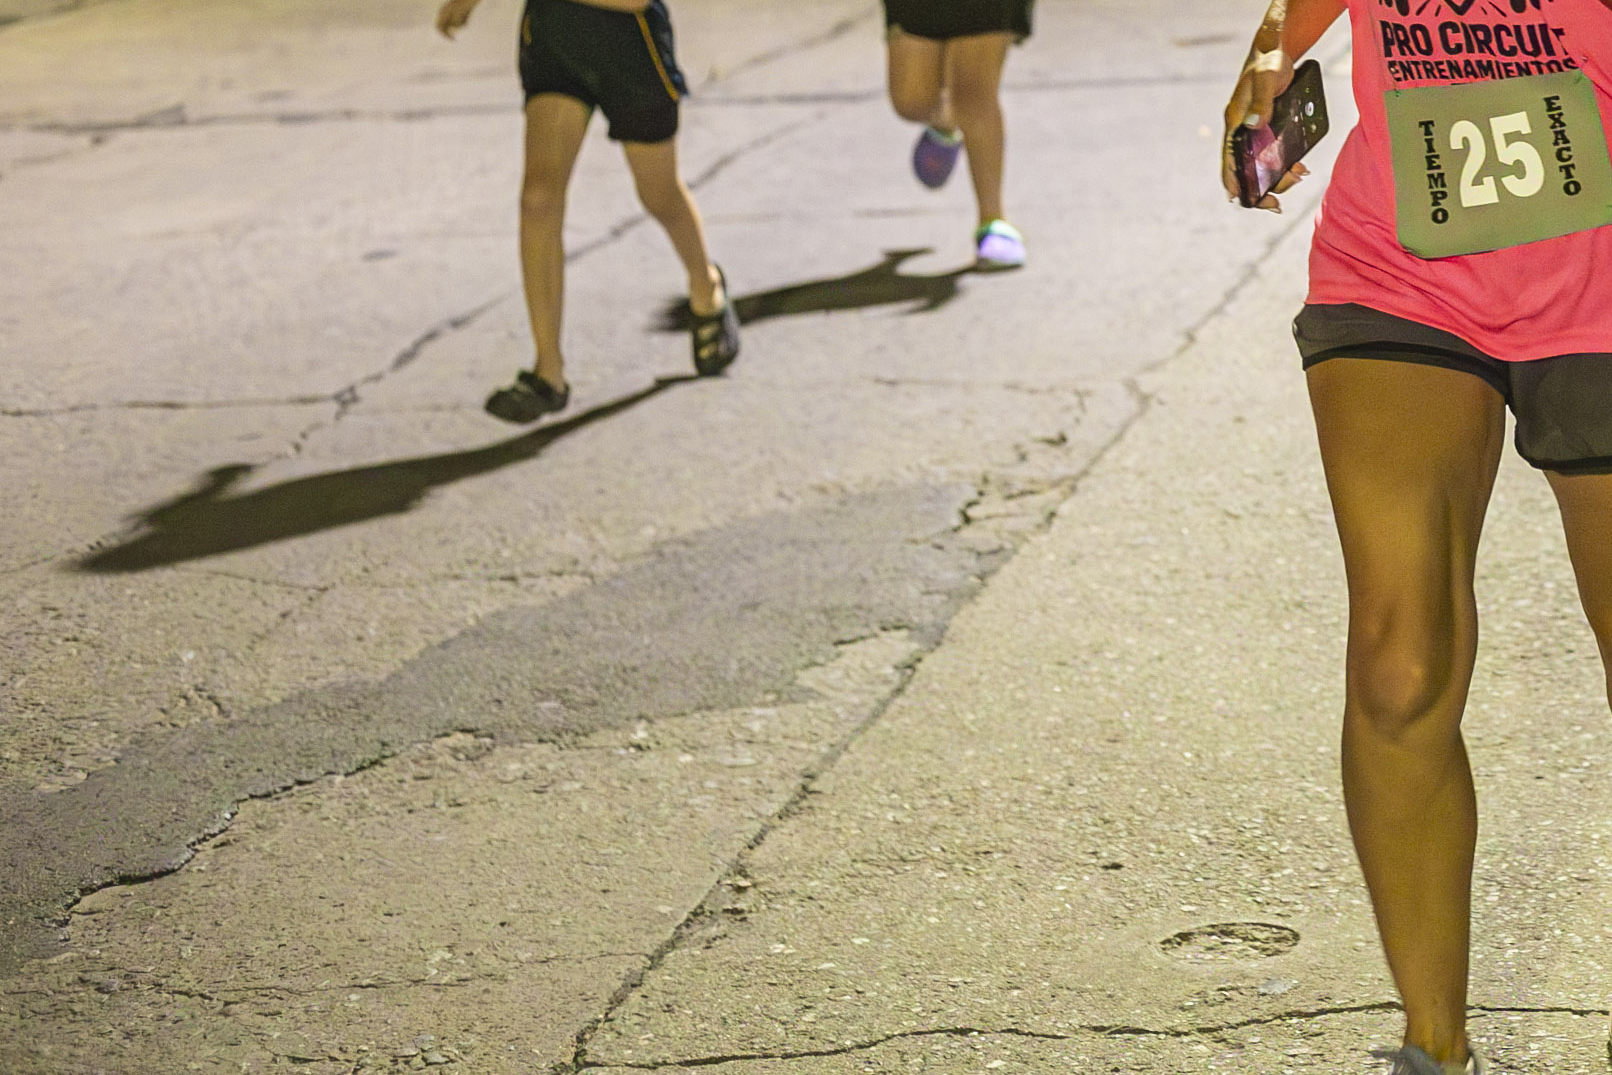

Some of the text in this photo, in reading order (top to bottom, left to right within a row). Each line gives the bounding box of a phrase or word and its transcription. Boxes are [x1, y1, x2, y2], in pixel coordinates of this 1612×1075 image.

[1379, 20, 1434, 58] PRO
[1418, 120, 1449, 224] TIEMPO
[1450, 111, 1545, 208] 25
[1543, 95, 1582, 196] EXACTO
